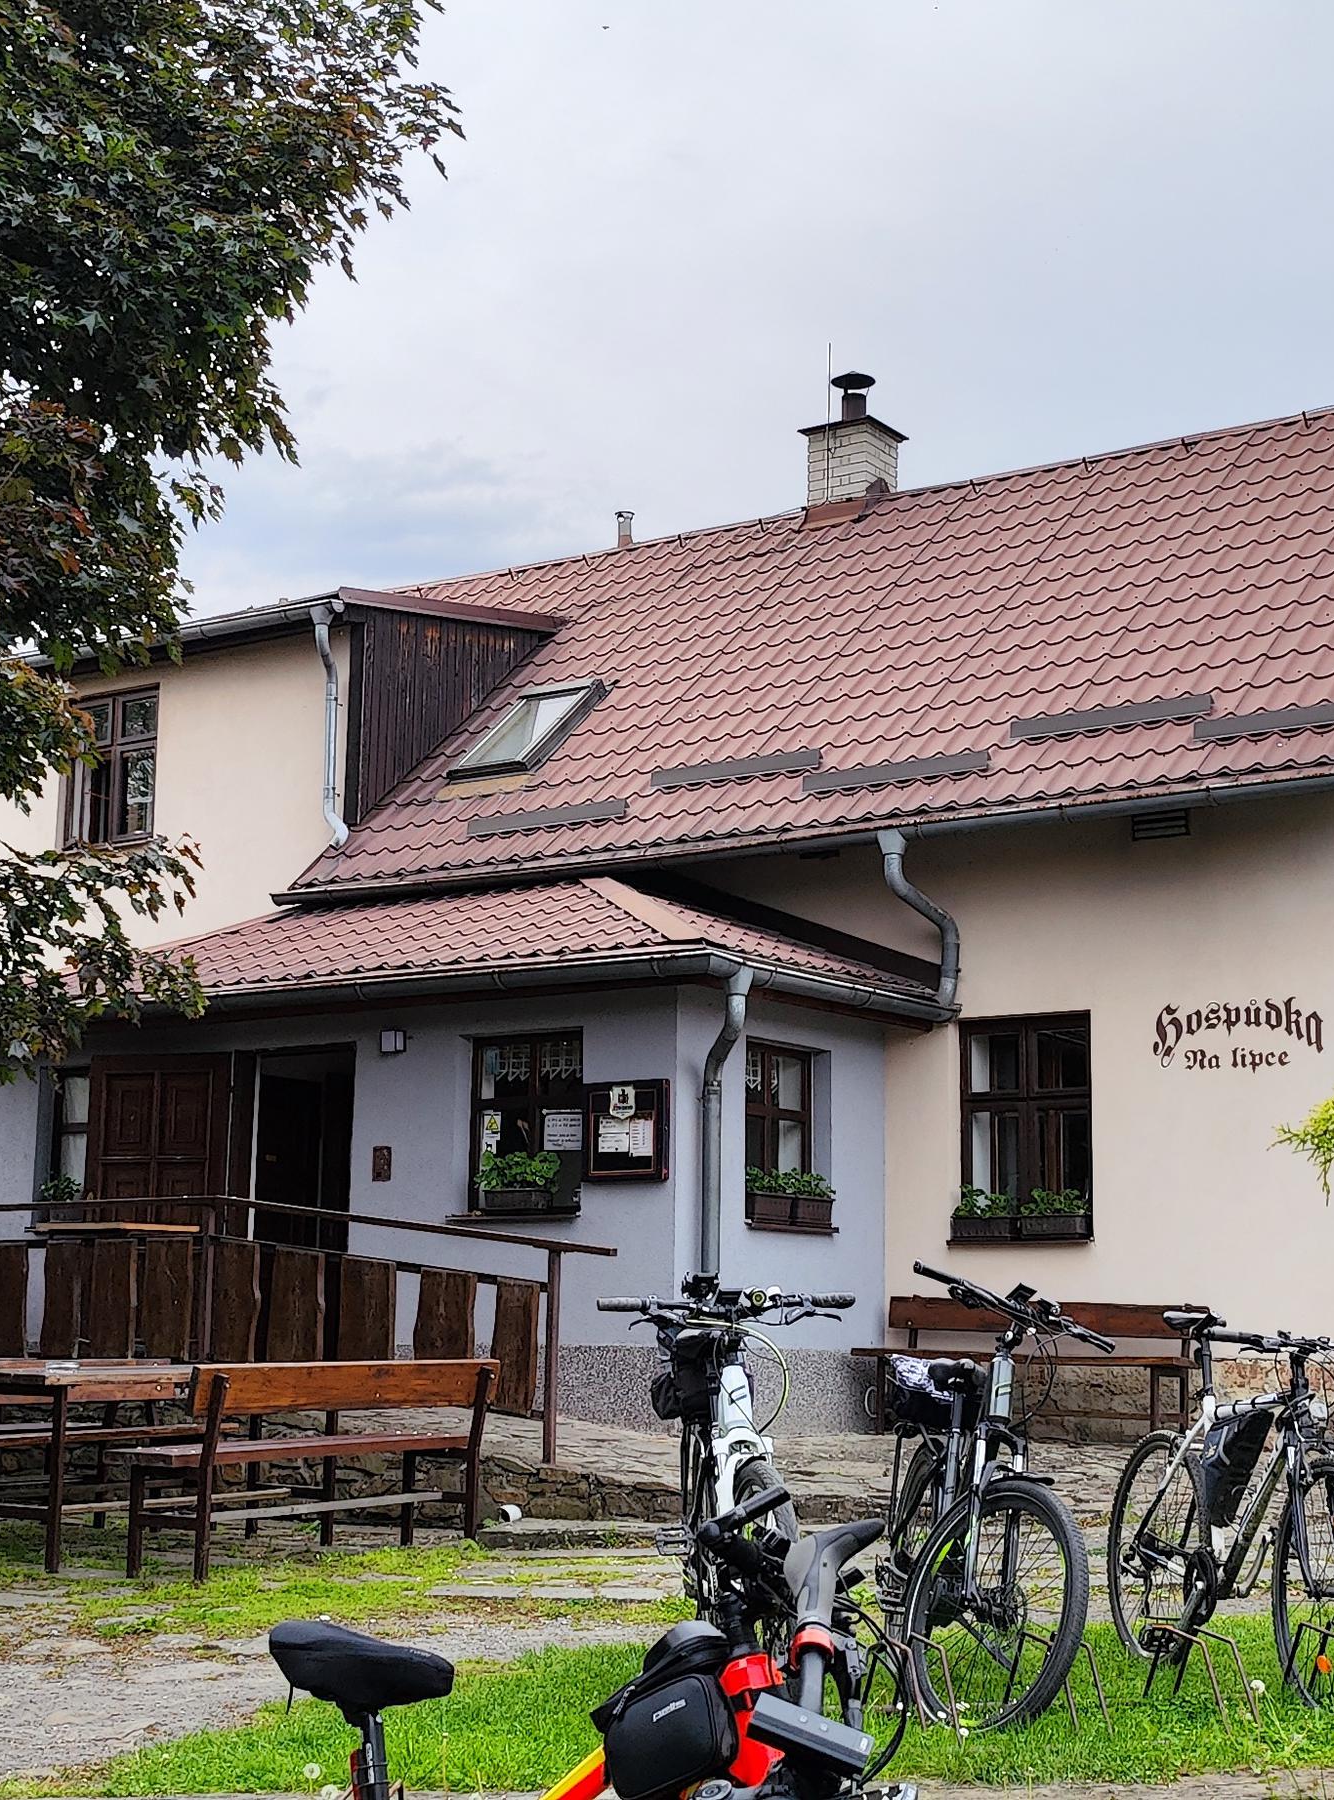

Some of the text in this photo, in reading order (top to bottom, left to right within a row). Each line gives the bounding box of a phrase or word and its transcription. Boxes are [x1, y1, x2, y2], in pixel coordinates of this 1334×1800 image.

[1153, 996, 1324, 1068] Hospůdka
[1184, 1047, 1291, 1074] Na lipce
